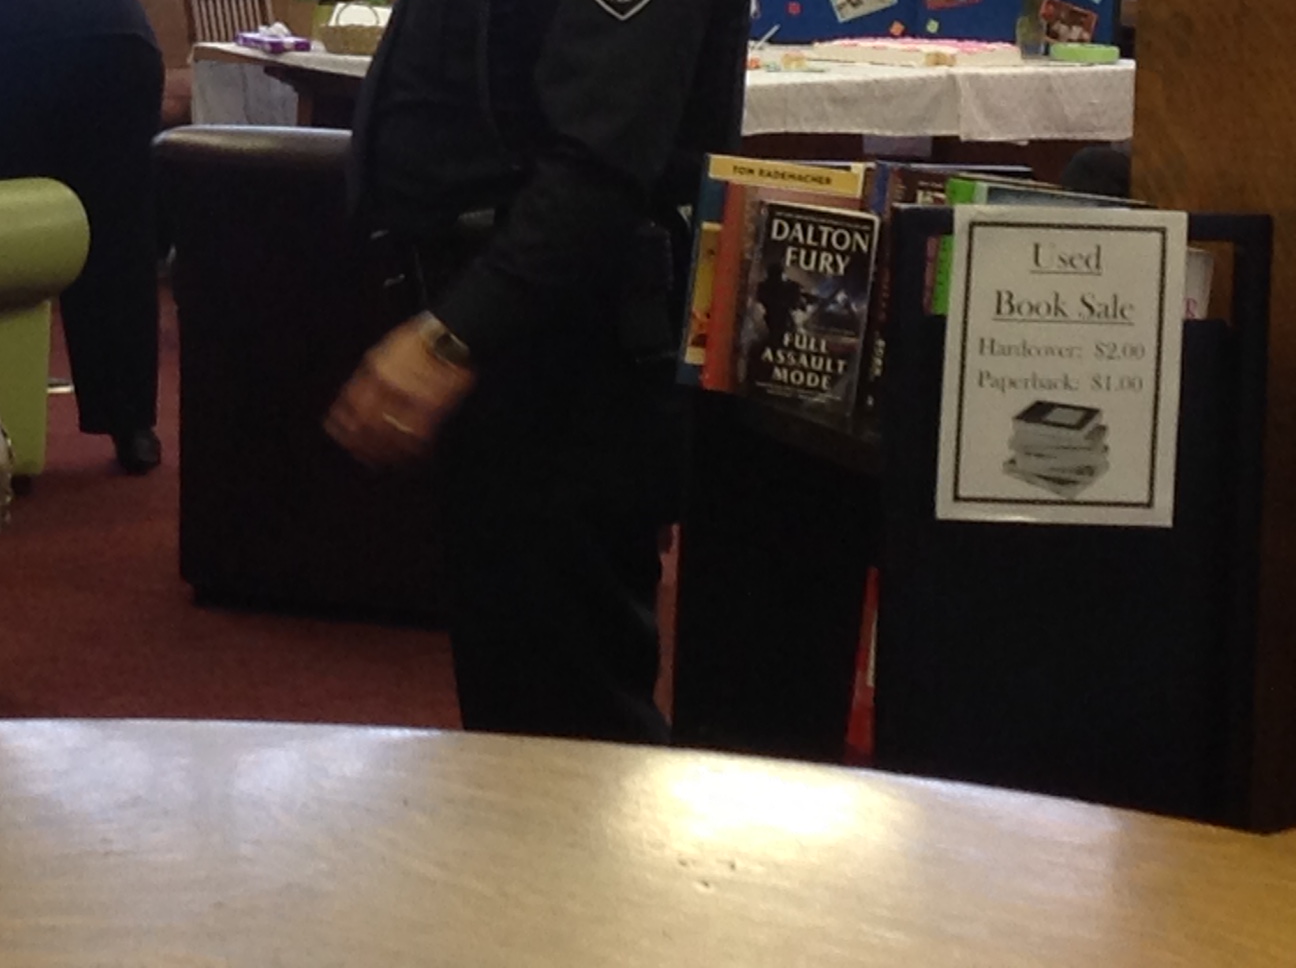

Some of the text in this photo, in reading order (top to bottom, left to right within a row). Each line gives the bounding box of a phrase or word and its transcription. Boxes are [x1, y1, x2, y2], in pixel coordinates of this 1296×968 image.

[732, 164, 833, 186] TOM RADEMACHER
[770, 218, 871, 254] DALTON
[784, 246, 851, 276] FURY
[1031, 241, 1102, 271] Used
[994, 289, 1135, 320] Book Sale
[782, 331, 829, 354] FULL
[1093, 341, 1146, 361] $2.00
[760, 346, 848, 375] ASSAULT
[771, 366, 834, 391] MODE
[1090, 373, 1144, 393] $1.00
